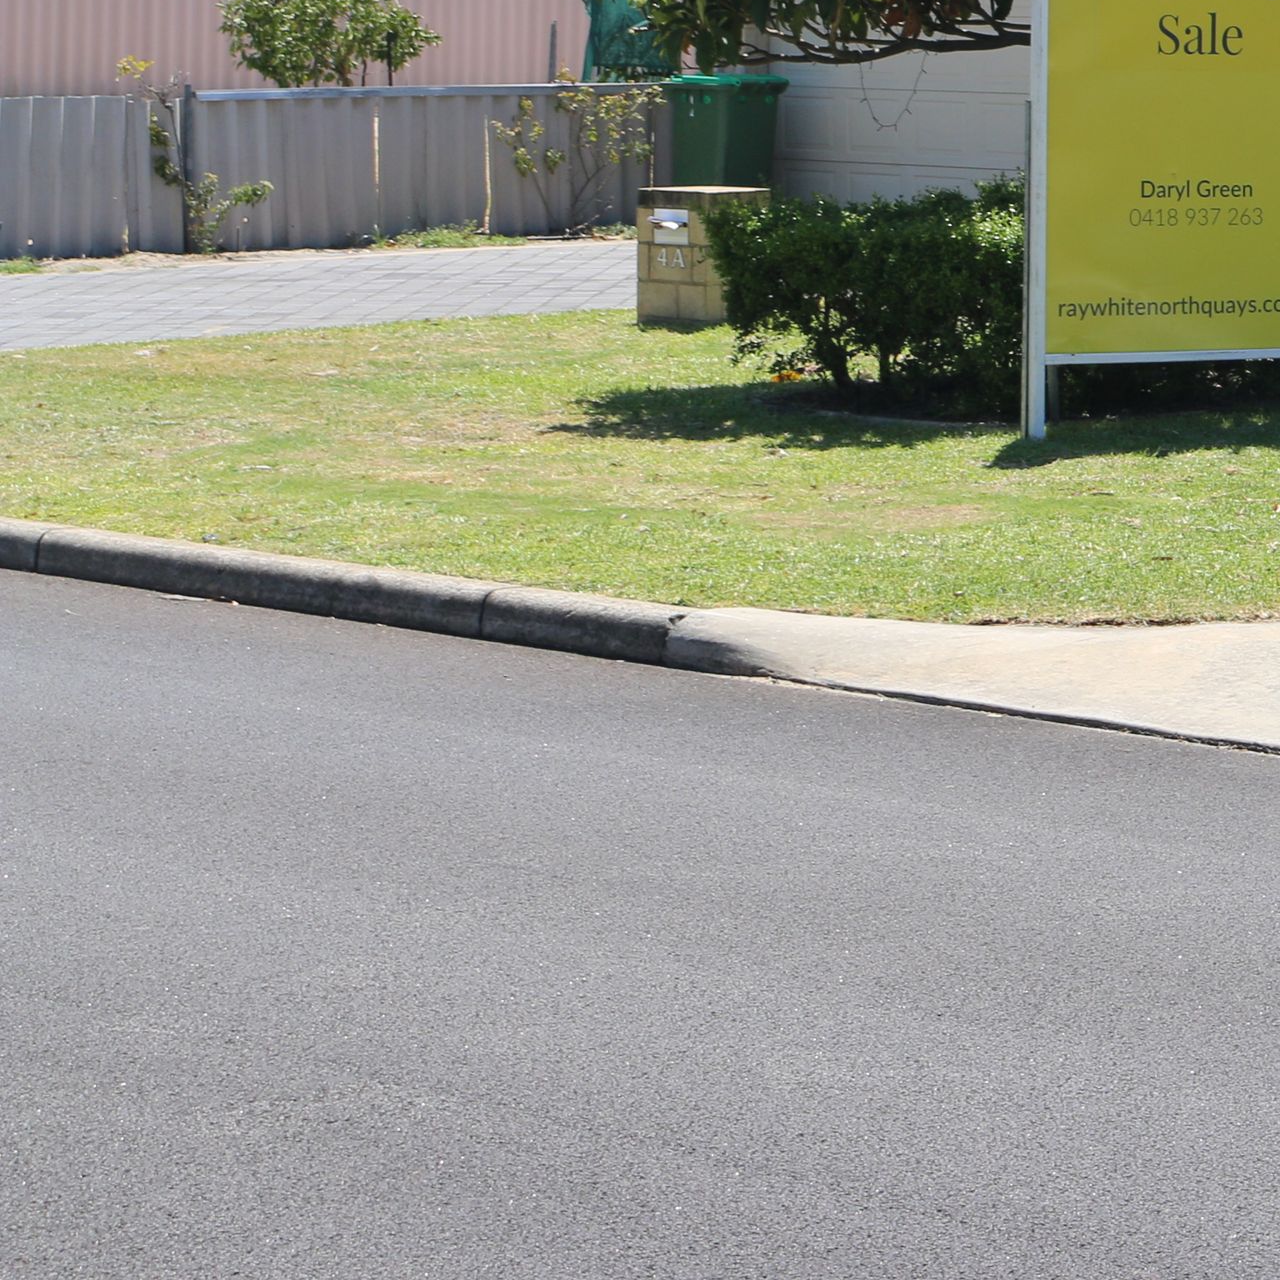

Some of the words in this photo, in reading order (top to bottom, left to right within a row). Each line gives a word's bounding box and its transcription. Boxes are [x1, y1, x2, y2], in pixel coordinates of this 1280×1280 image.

[1157, 12, 1243, 56] Sale
[1140, 179, 1190, 202] Daryl
[1196, 180, 1253, 198] Green
[1129, 208, 1179, 227] 0418
[1185, 208, 1221, 226] 937
[1227, 207, 1264, 226] 263
